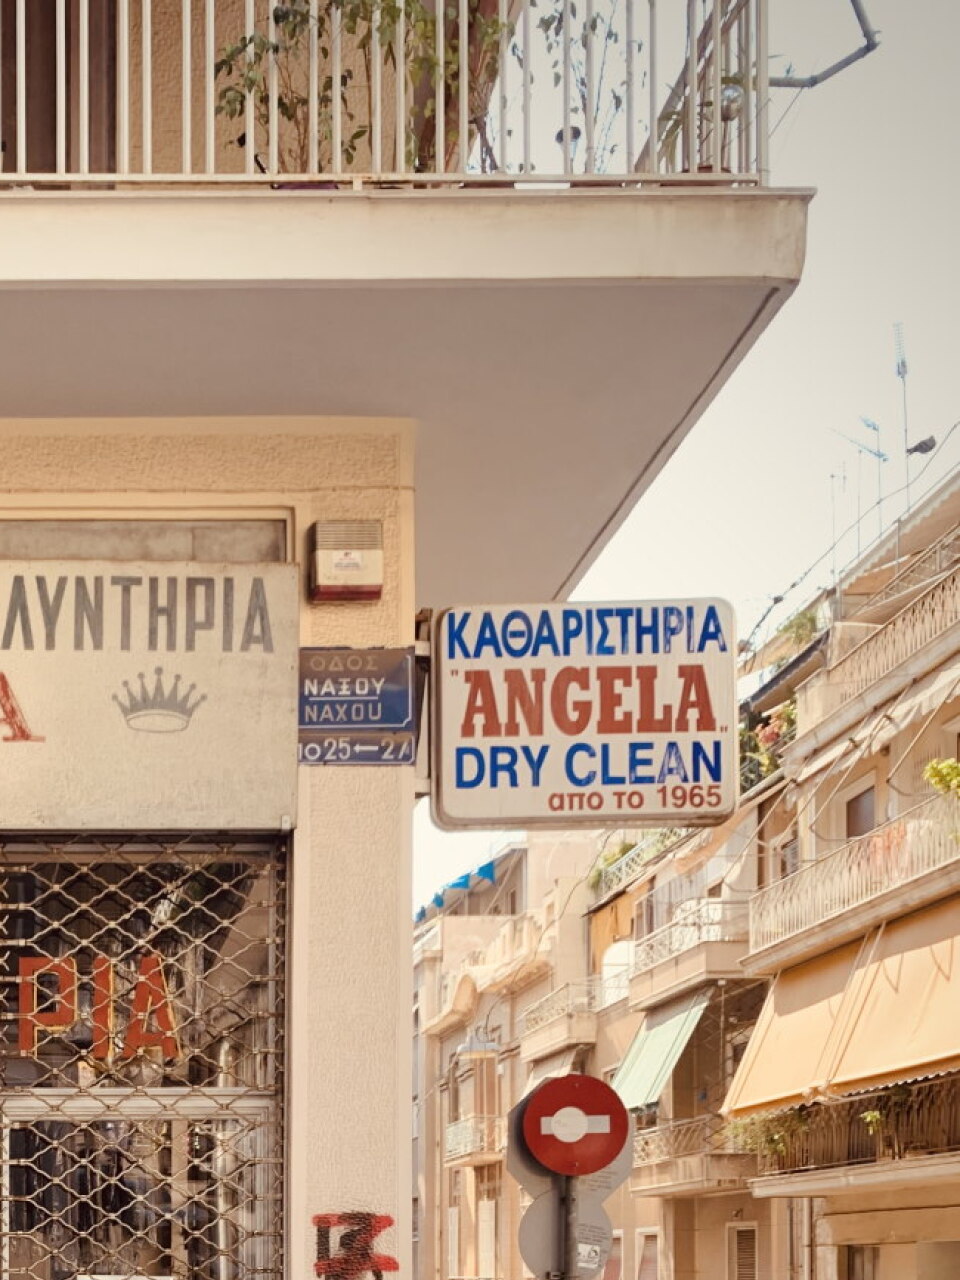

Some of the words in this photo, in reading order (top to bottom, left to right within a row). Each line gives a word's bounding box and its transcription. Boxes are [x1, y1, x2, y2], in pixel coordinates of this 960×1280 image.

[447, 605, 728, 660] ΚΑΘΑΡΙΣΤΗΡΙΑ
[310, 655, 380, 672] ΟΔΟΣ
[304, 677, 385, 697] ΝΑΞΟΥ
[305, 702, 382, 722] NAXOU
[324, 737, 351, 760] 25
[455, 745, 550, 789] DRY
[565, 740, 723, 788] CLEAN
[549, 791, 604, 812] απο
[657, 785, 723, 809] 1965
